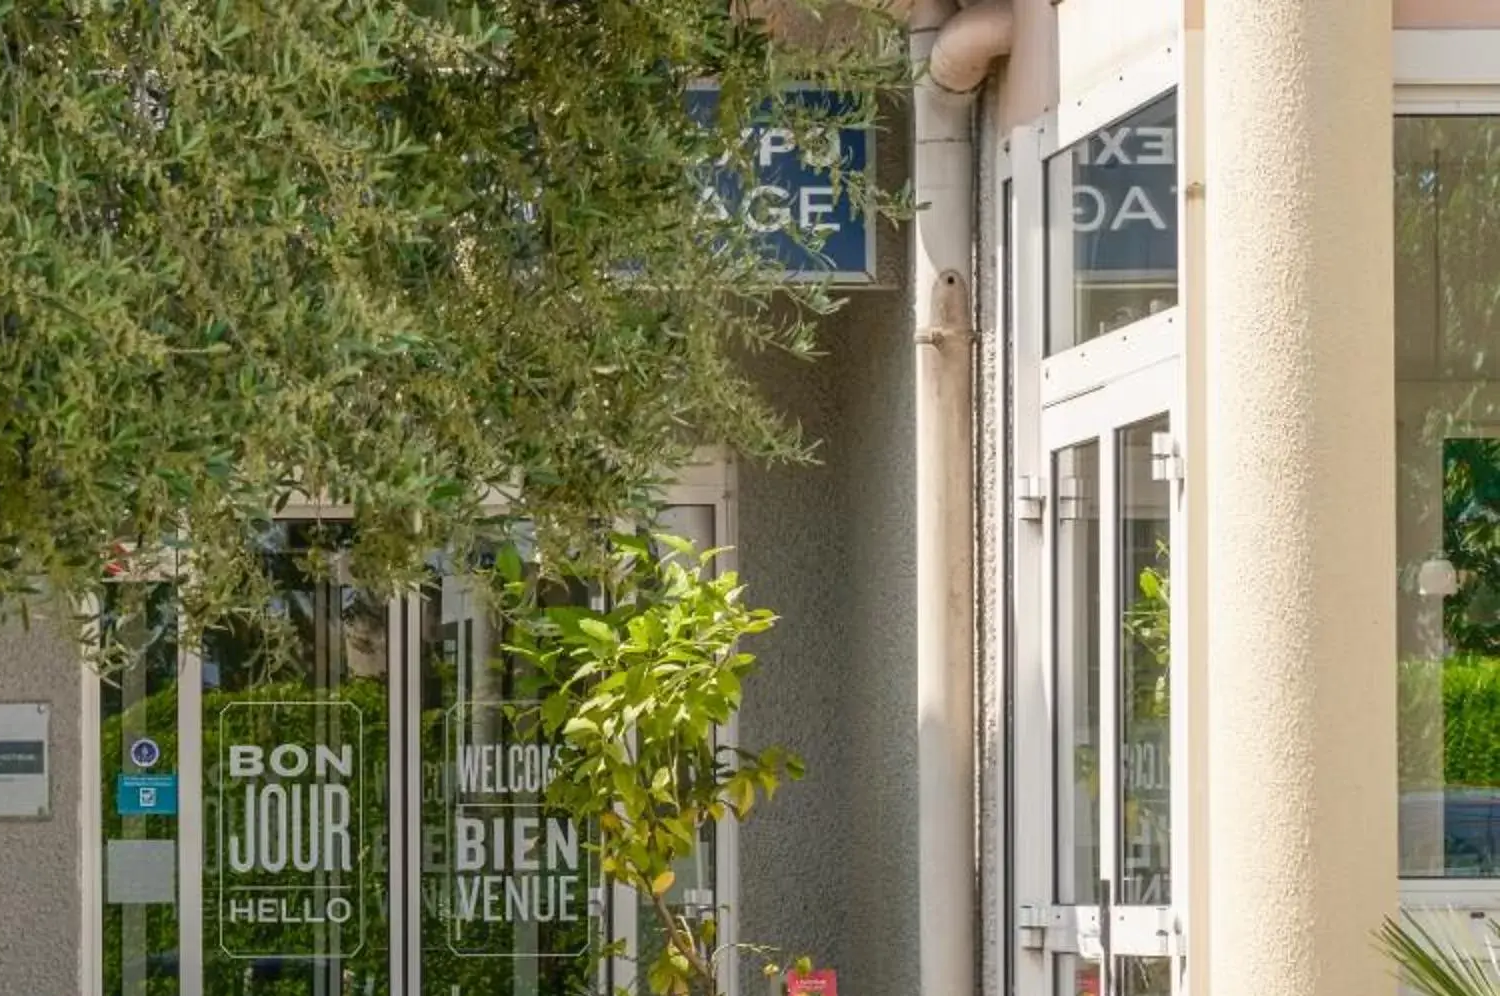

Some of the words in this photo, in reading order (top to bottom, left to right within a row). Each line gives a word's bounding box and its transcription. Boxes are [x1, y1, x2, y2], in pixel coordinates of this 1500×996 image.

[229, 743, 353, 777] BON
[457, 743, 578, 794] WELCOM
[229, 783, 353, 873] JOUR
[456, 817, 579, 871] BIEN
[229, 897, 352, 923] HELLO
[457, 875, 579, 922] VENUE
